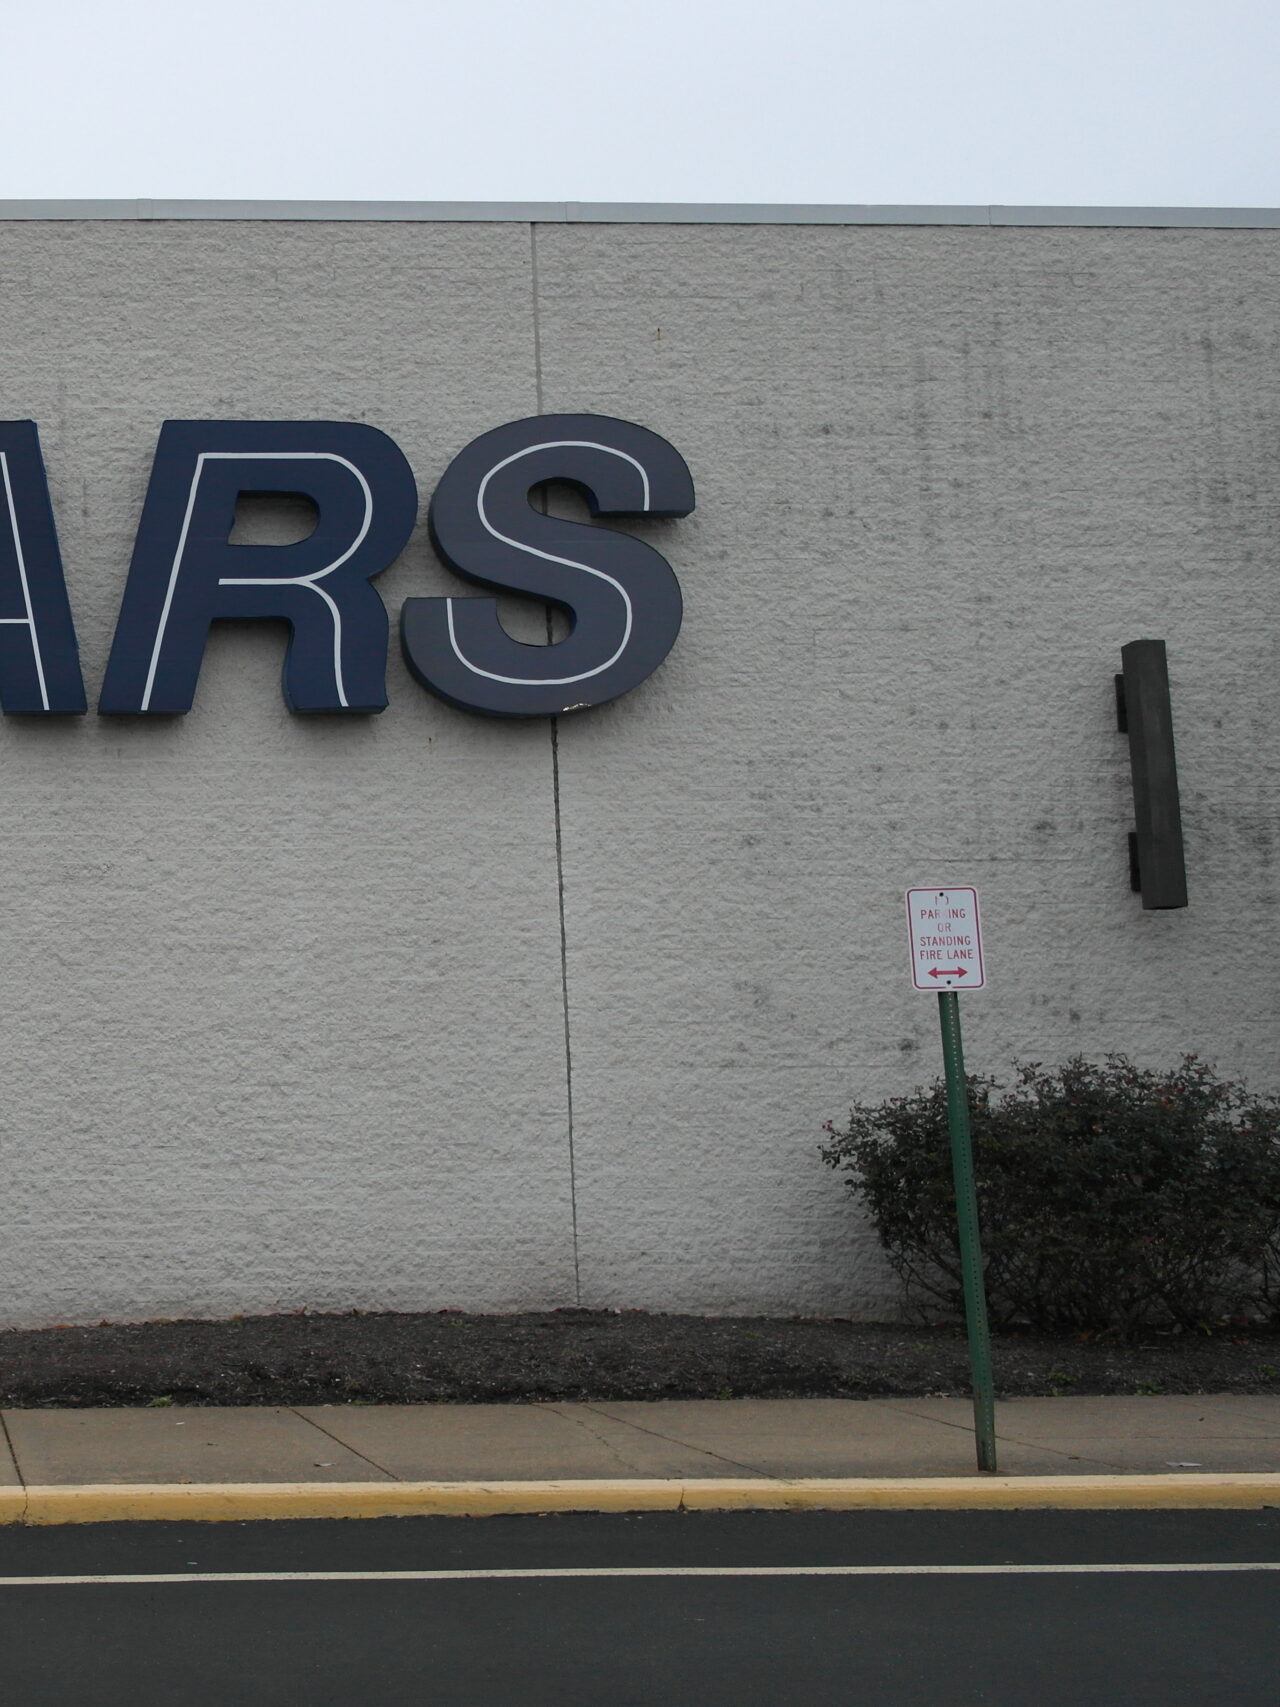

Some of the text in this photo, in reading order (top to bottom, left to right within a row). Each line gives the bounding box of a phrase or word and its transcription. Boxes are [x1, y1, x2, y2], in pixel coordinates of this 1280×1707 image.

[920, 908, 966, 919] PARING
[937, 922, 952, 932] OR
[920, 936, 971, 946] STANDING
[920, 949, 974, 960] FIRE LANE
